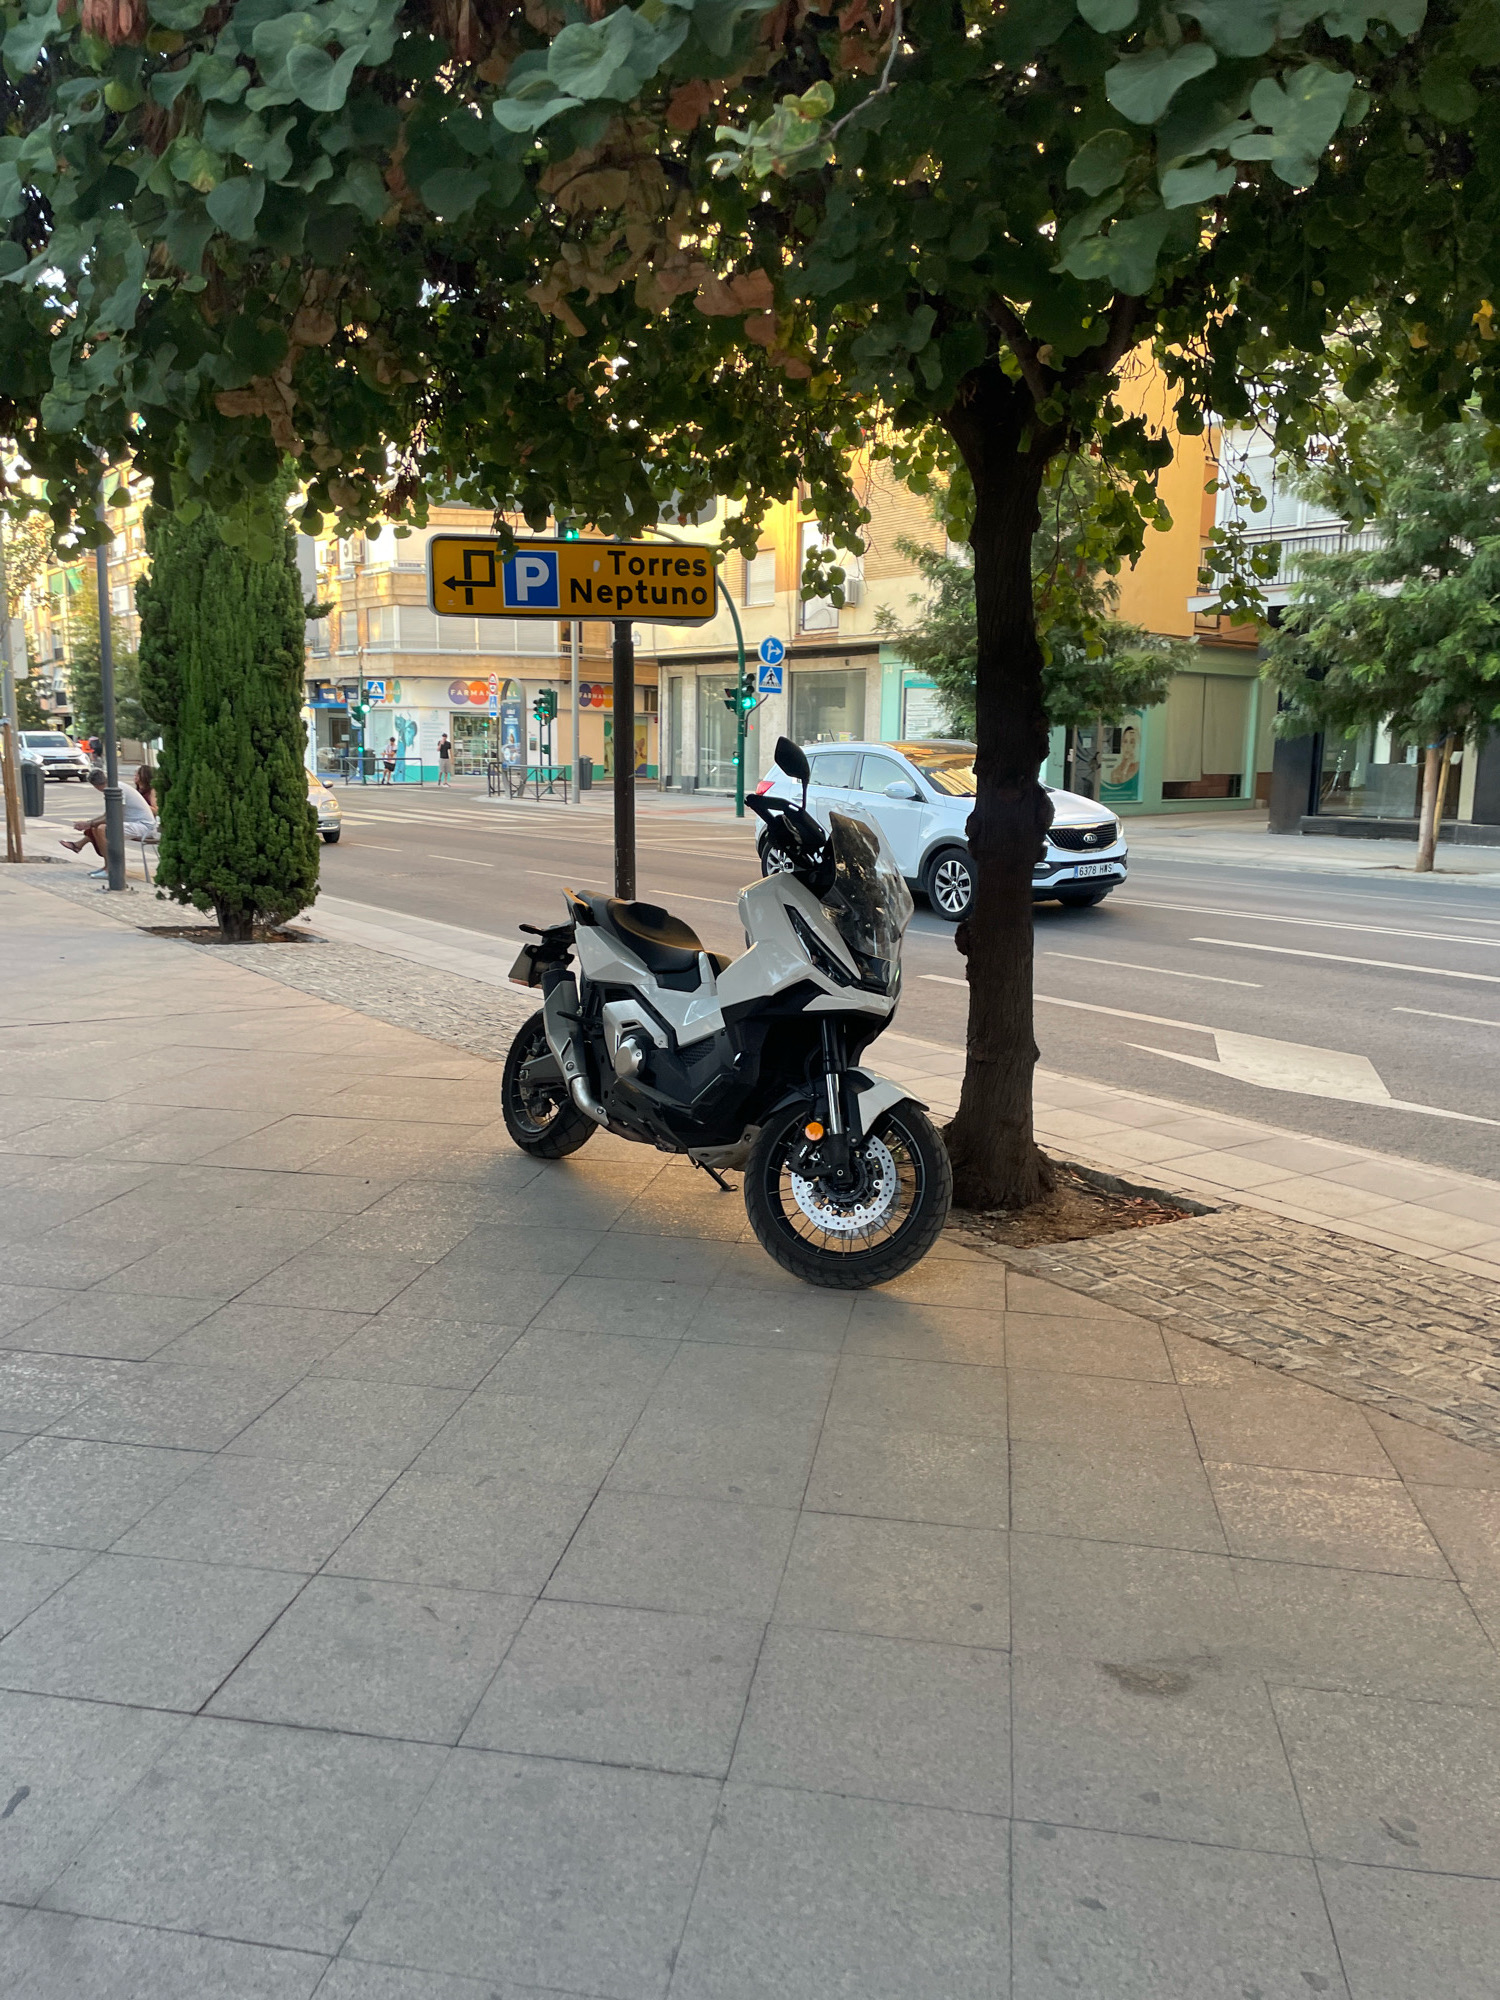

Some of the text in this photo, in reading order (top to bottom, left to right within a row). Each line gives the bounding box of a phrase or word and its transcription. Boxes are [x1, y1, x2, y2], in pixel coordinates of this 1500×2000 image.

[607, 550, 708, 577] Torres
[570, 578, 708, 610] Neptuno
[1079, 865, 1097, 876] 6378
